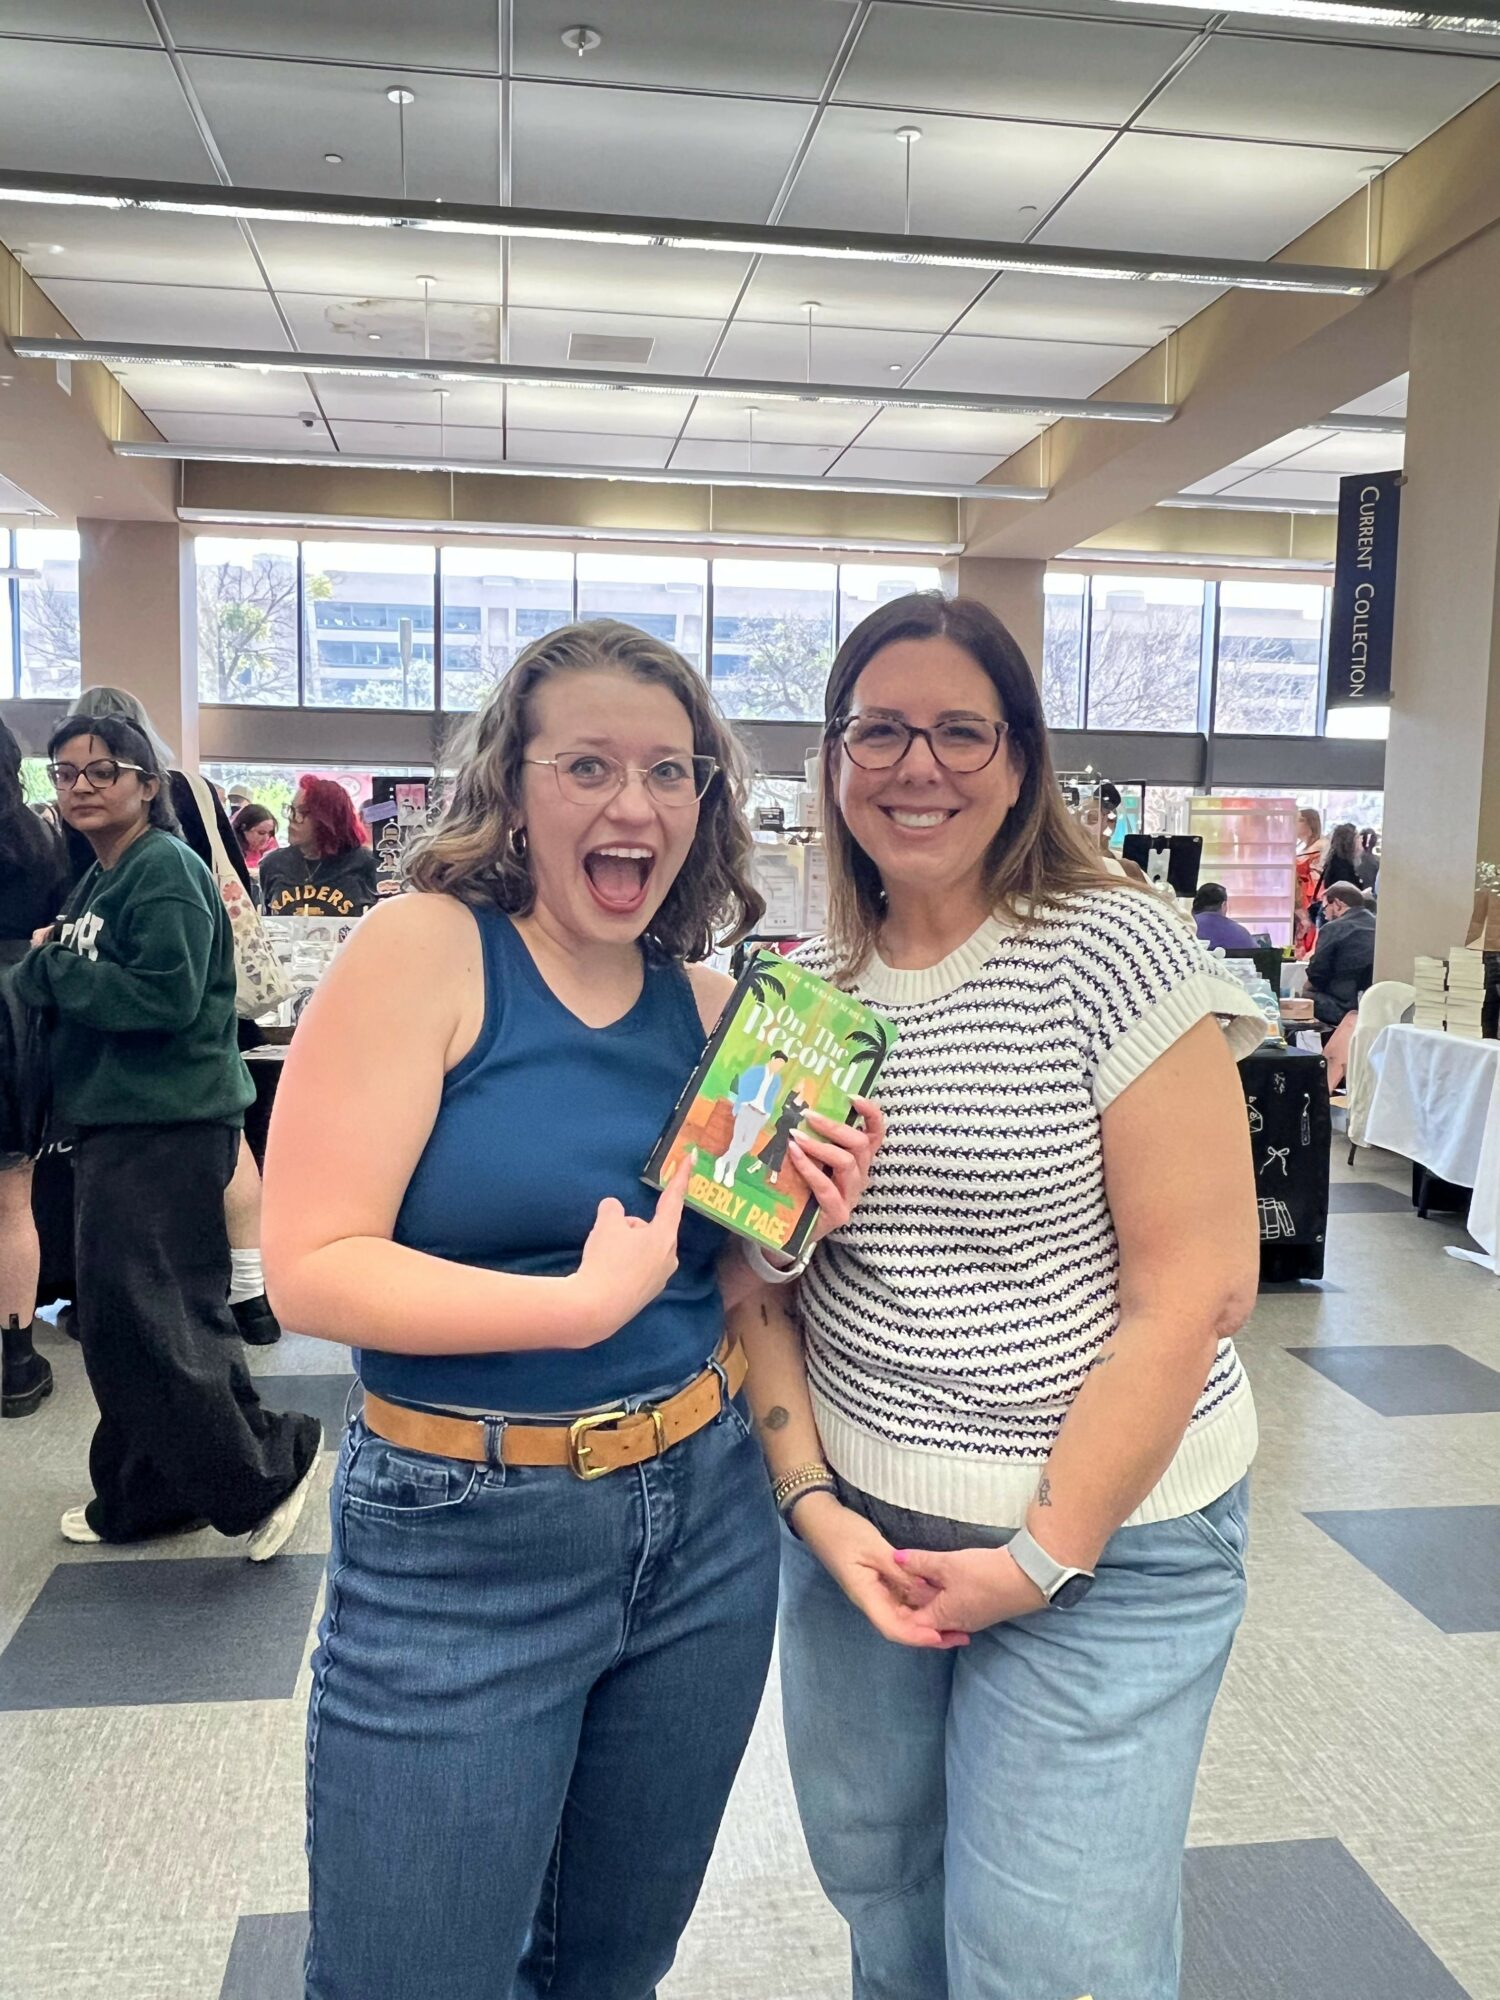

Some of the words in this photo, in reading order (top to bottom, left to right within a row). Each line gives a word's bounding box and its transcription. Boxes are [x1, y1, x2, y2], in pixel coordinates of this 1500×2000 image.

[1357, 486, 1380, 571] CURRENT
[1349, 583, 1375, 697] COLLECTION
[742, 1001, 859, 1092] Record
[777, 1005, 806, 1037] On
[814, 1024, 849, 1060] The
[744, 1203, 790, 1245] PAGE
